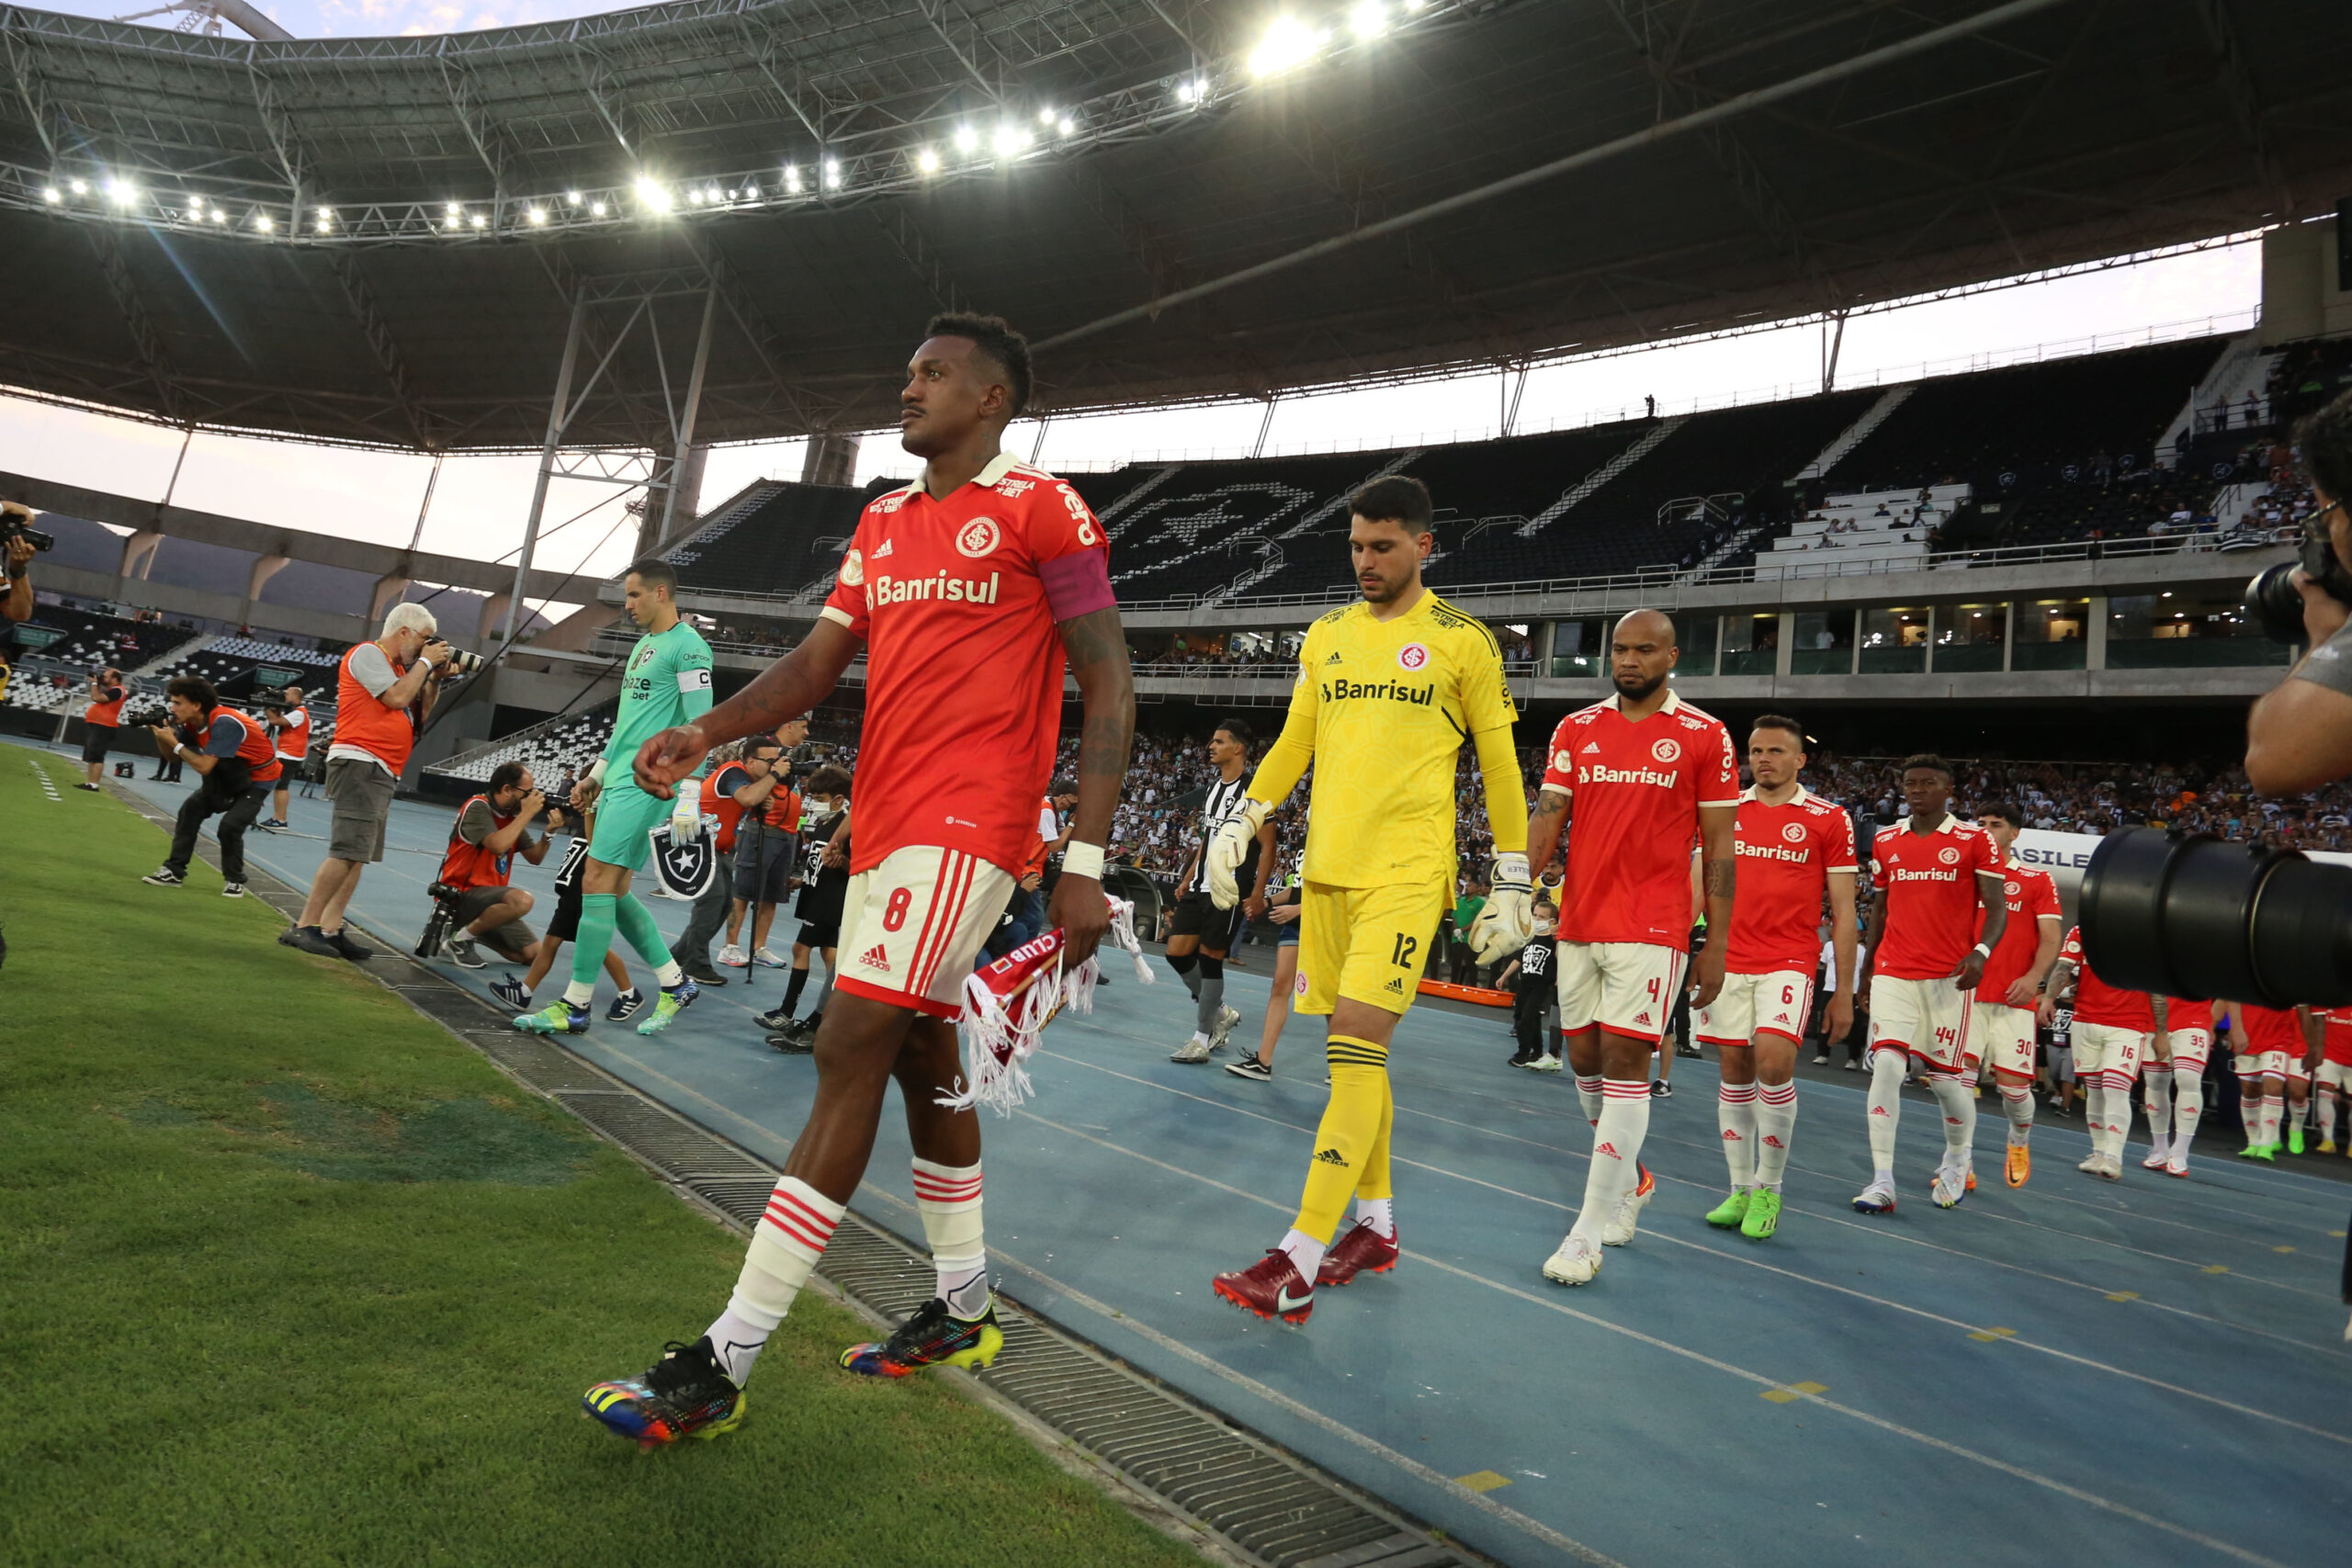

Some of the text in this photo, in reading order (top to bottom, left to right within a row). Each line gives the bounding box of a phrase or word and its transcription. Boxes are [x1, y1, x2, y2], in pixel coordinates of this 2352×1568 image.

[1056, 483, 1097, 546] vero
[876, 569, 1000, 606] Banrisul
[1430, 609, 1465, 629] ESTRELA
[1437, 619, 1454, 630] BET
[699, 671, 709, 684] C
[1335, 679, 1434, 706] Banrisul
[1592, 764, 1679, 789] Banrisul
[1734, 840, 1810, 863] Banrisul
[1896, 867, 1958, 882] Banrisul
[883, 887, 912, 932] 8
[1010, 934, 1057, 963] CLUB
[1392, 932, 1417, 969] 12
[858, 955, 890, 972] adidas
[1647, 976, 1661, 1003] 4
[1781, 985, 1793, 1005] 6
[1935, 1026, 1956, 1046] 44
[2190, 1034, 2205, 1048] 35
[2016, 1038, 2031, 1056] 30
[2121, 1044, 2134, 1059] 16
